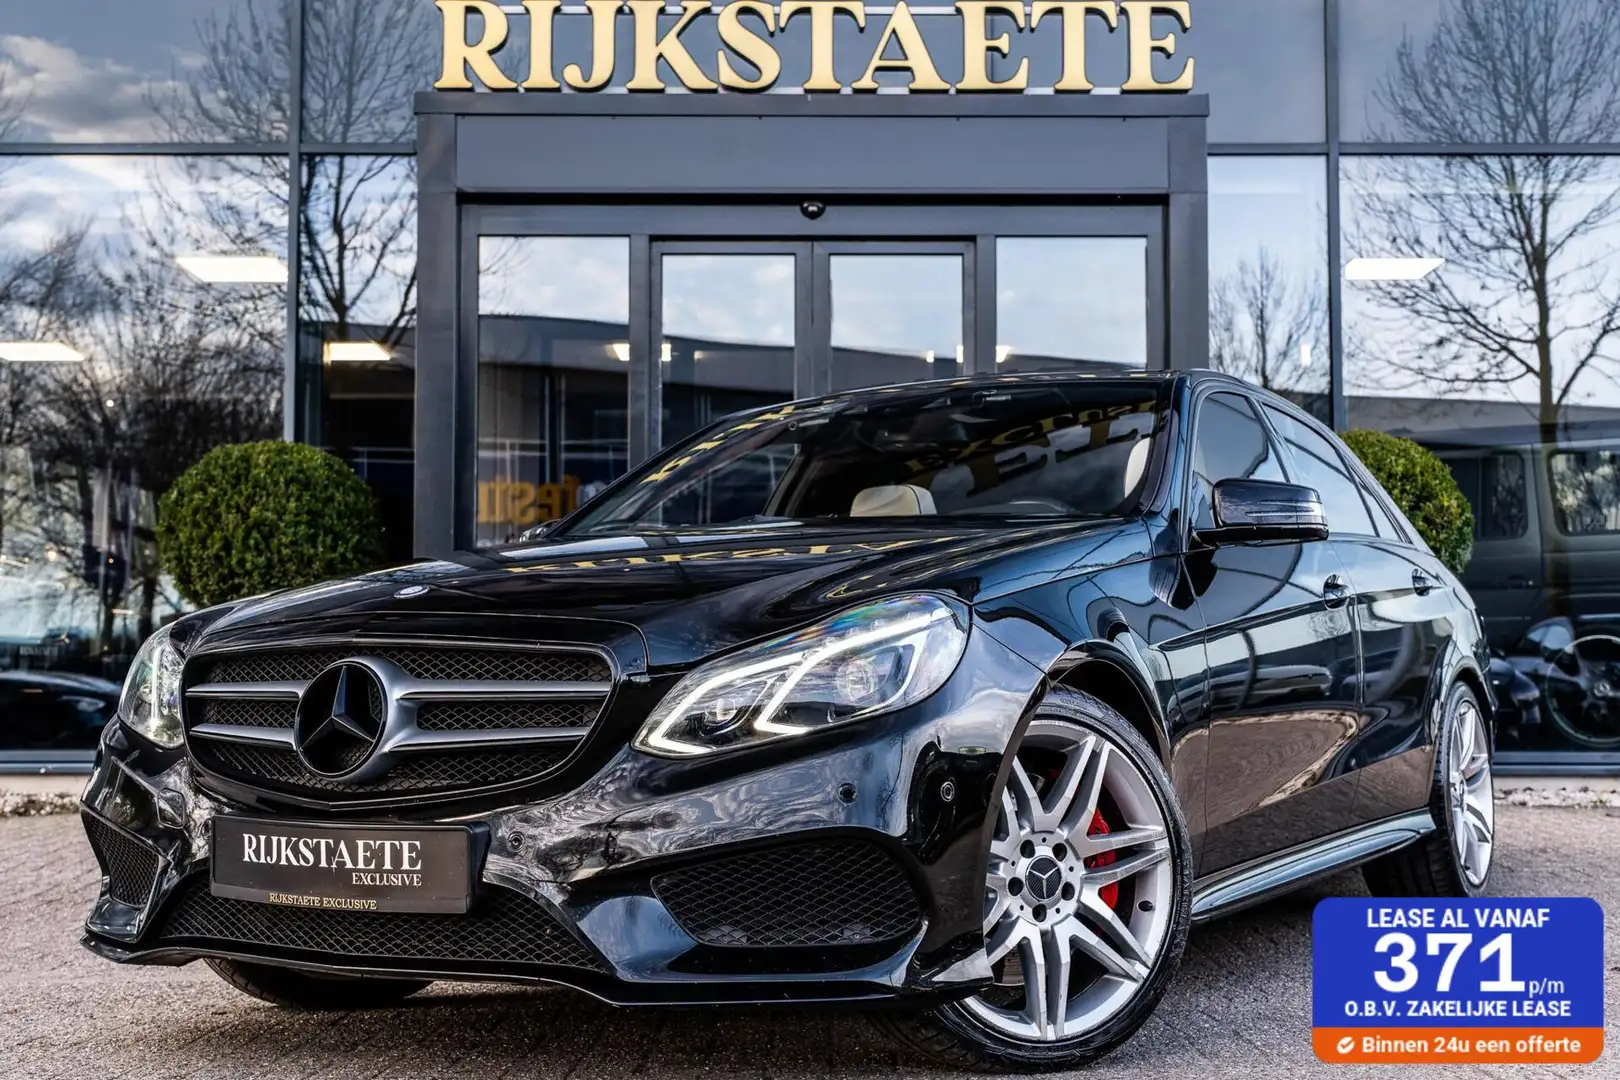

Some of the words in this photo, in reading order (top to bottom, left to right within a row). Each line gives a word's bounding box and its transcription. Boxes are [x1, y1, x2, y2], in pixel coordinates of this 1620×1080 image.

[434, 0, 1196, 92] RIJKSTAETE
[242, 833, 422, 871] RIJKSTAETE
[352, 872, 422, 886] EXCLUSIVE
[269, 892, 321, 908] RIJKSTAETE
[322, 897, 377, 910] EXCLUSIVE
